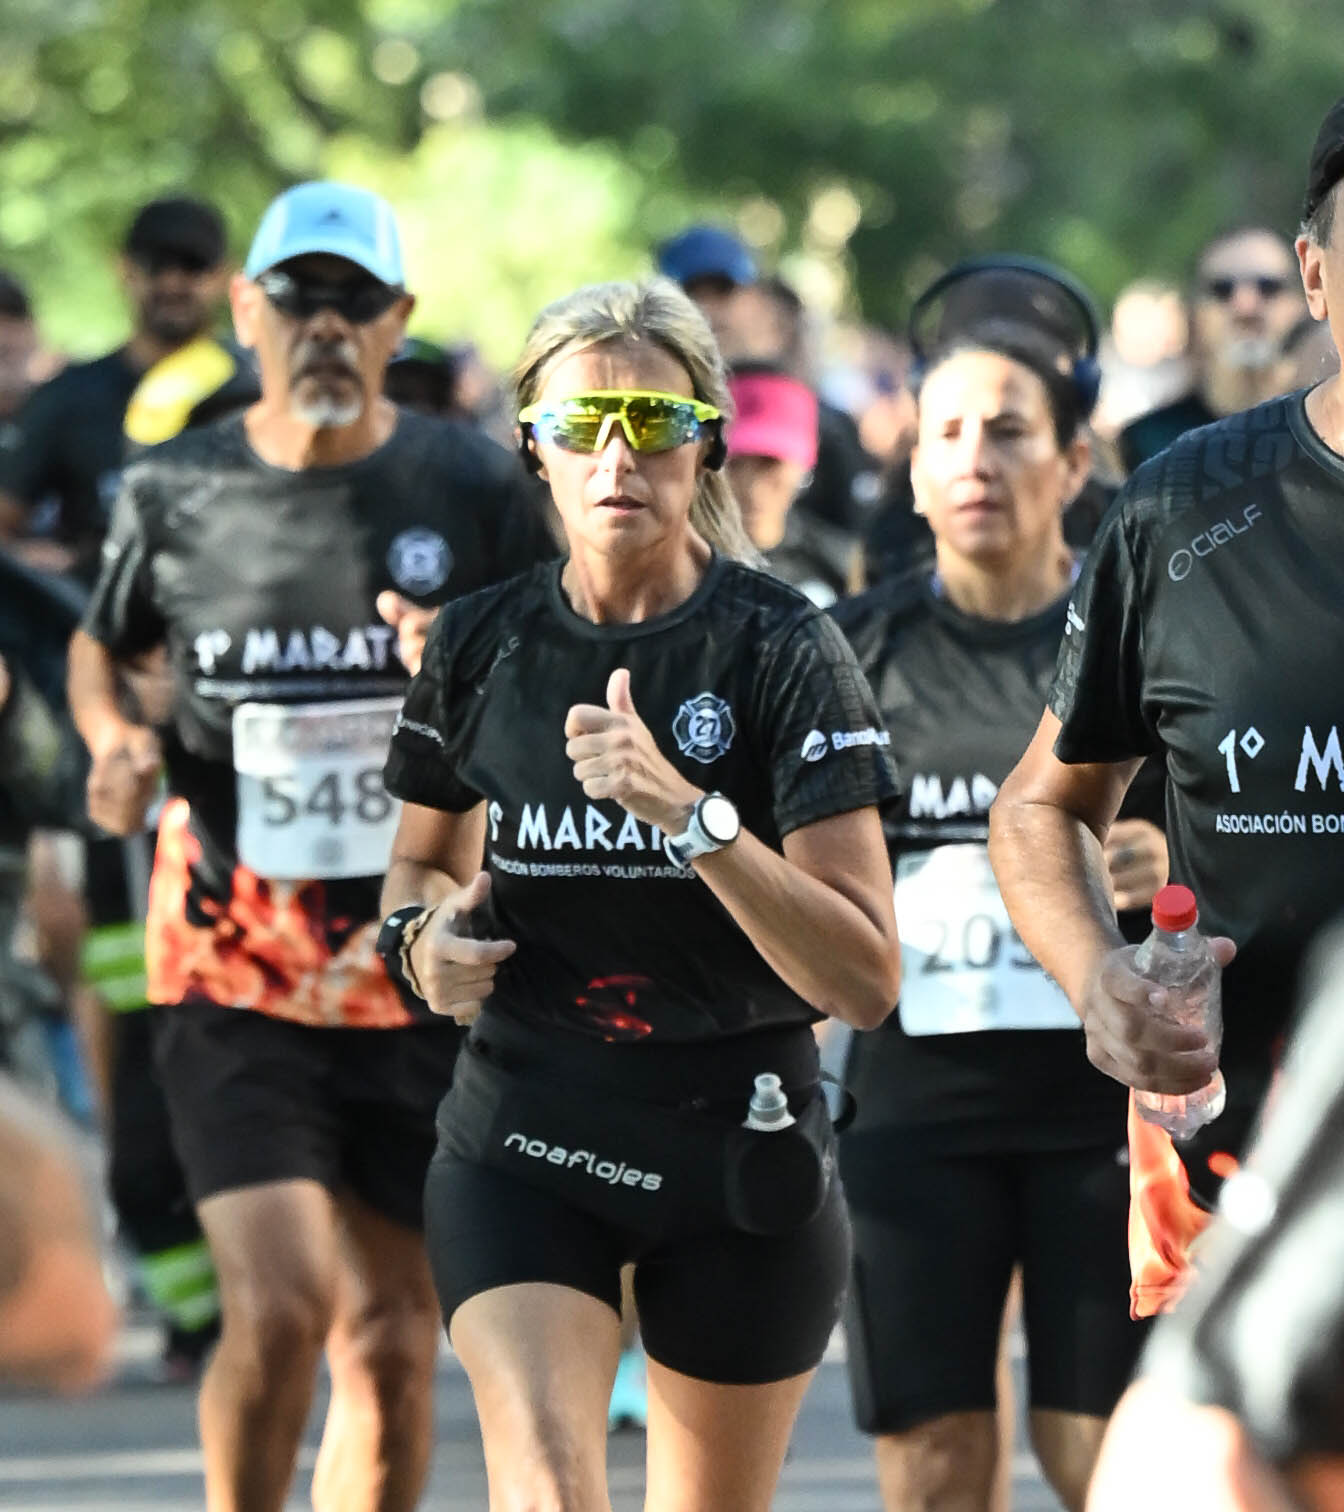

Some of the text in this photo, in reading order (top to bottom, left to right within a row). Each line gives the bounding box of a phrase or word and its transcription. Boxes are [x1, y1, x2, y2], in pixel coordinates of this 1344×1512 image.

[240, 623, 402, 674] MARAT
[261, 768, 392, 826] 548
[1215, 809, 1307, 835] ASOCIACIÓN
[529, 862, 600, 878] BOMBEROS
[602, 864, 696, 880] VOLUNTARIOS
[503, 1132, 663, 1191] noaflojes
